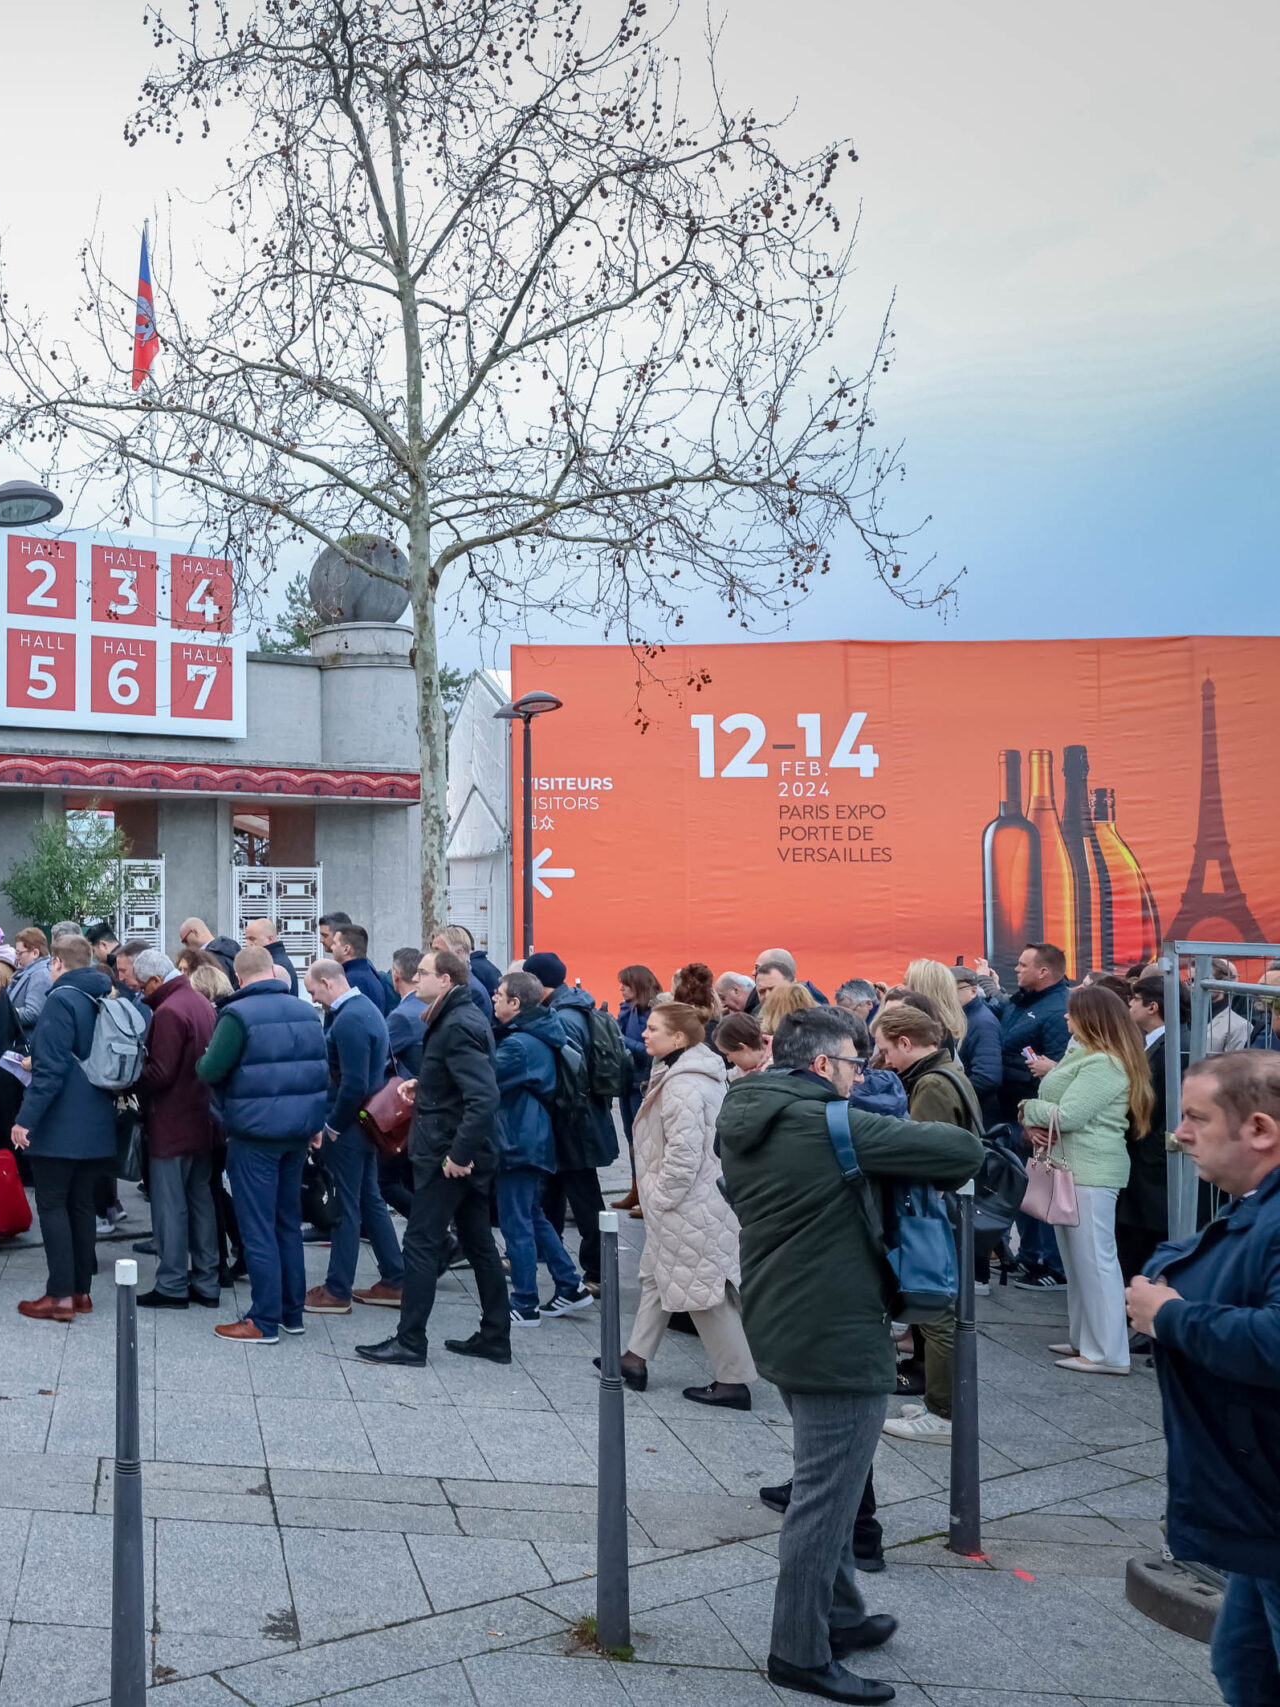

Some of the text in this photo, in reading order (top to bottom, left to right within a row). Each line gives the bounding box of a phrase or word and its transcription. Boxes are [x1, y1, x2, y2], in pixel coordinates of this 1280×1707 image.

[21, 541, 65, 559] HALL
[104, 551, 146, 568] HALL
[182, 560, 223, 576] HALL
[25, 559, 57, 608] 2
[108, 568, 139, 615] 3
[186, 578, 220, 622] 4
[20, 634, 65, 650] HALL
[103, 641, 146, 656] HALL
[182, 648, 223, 663] HALL
[26, 655, 57, 700] 5
[107, 659, 140, 706] 6
[186, 664, 217, 710] 7
[781, 761, 829, 776] FEB.
[778, 782, 830, 797] 2024
[779, 805, 886, 820] PARIS EXPO
[779, 826, 874, 841] PORTE DE
[777, 847, 893, 863] VERSAILLES
